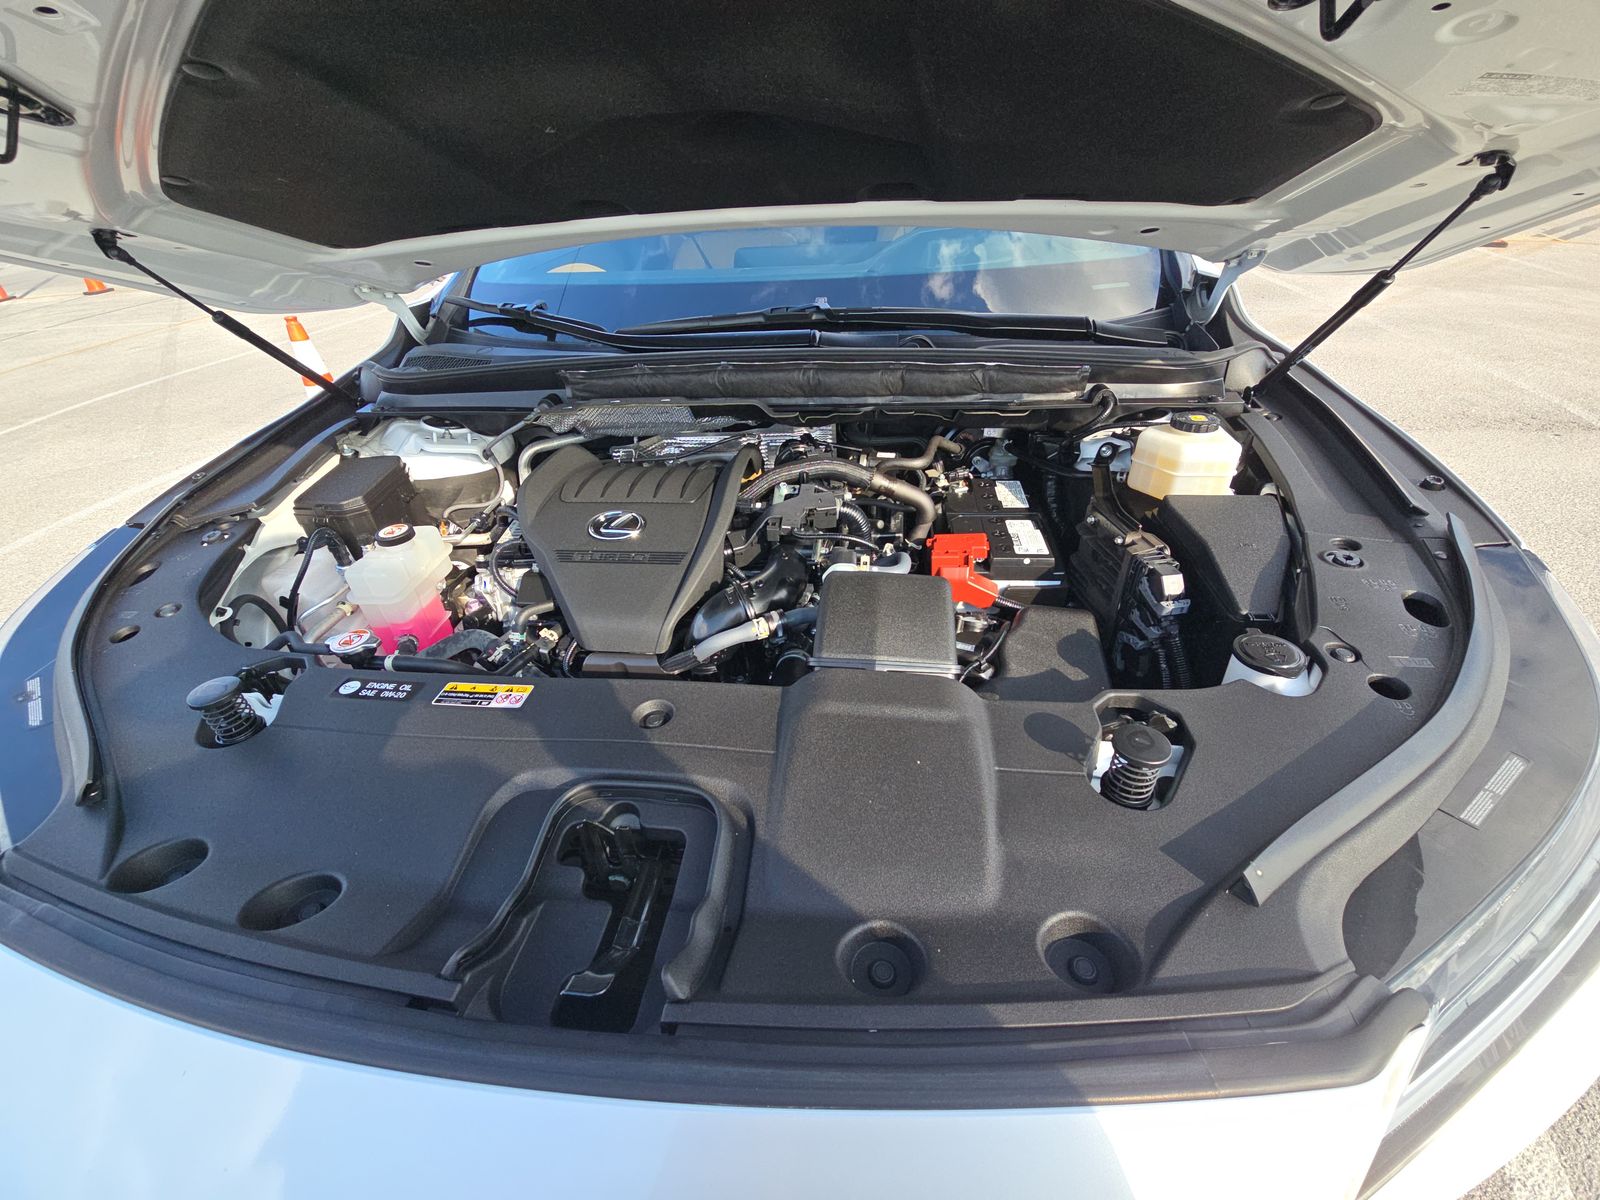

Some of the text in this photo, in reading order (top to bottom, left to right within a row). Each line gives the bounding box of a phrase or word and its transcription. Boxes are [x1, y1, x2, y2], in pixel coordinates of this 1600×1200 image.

[365, 682, 412, 692] ENGINE OIL
[358, 689, 407, 699] SAE 0W-20
